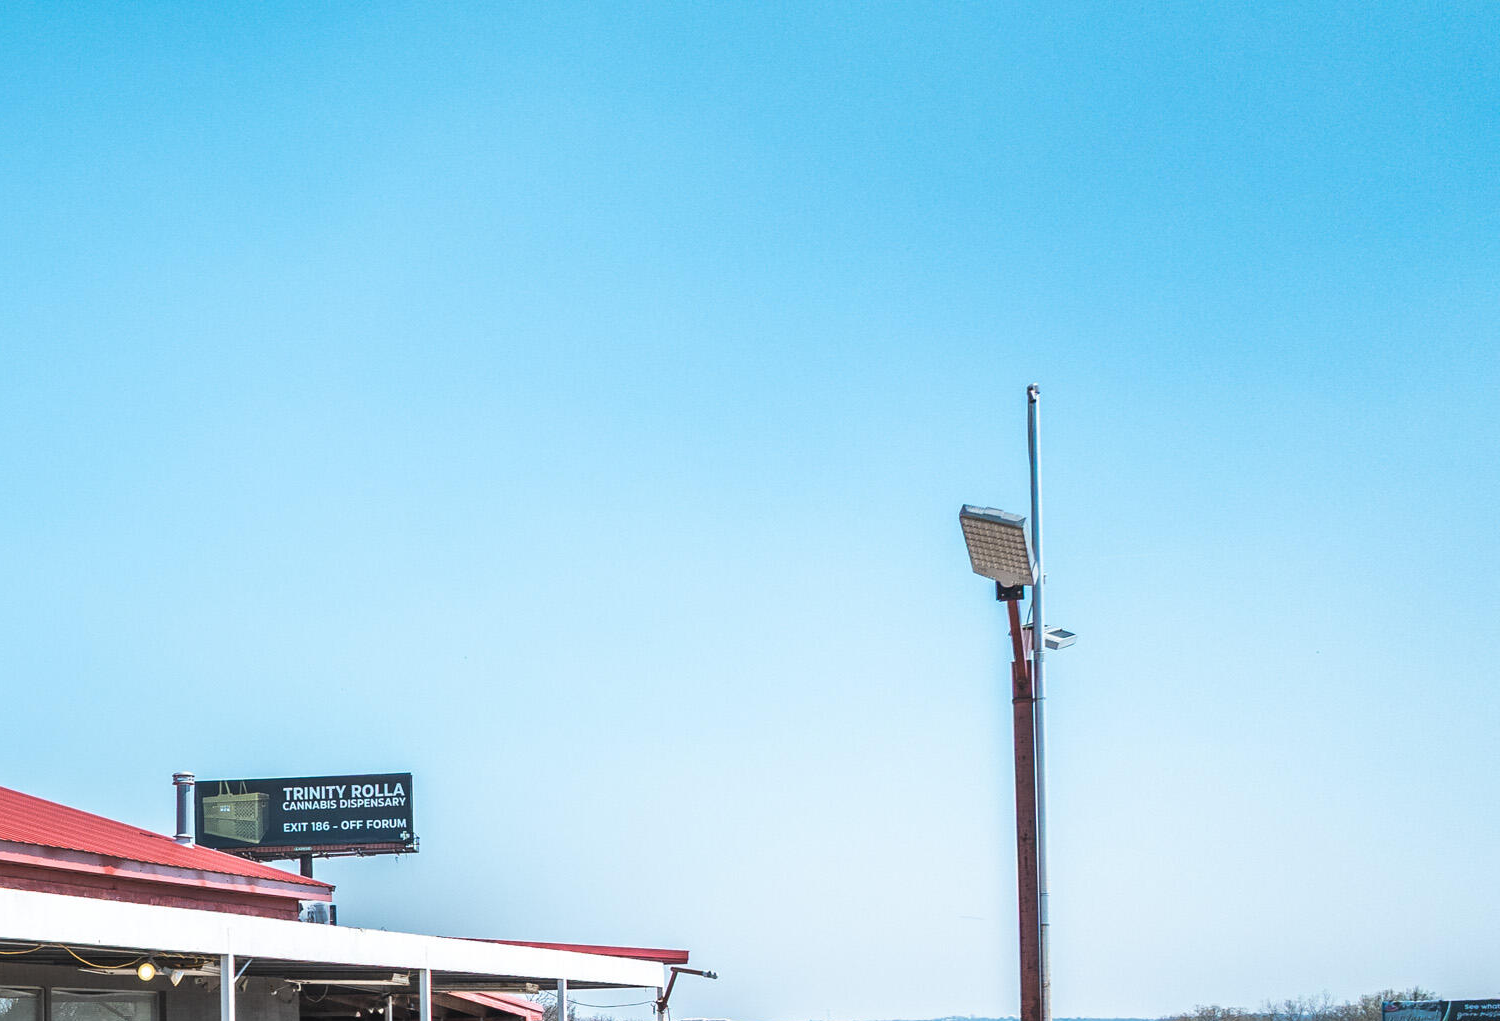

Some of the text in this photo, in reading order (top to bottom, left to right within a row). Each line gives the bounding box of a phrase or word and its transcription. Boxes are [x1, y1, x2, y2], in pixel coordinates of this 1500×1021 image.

[283, 782, 405, 801] TRINITY ROLLA
[282, 797, 406, 811] CANNABIS DISPENSARY
[283, 822, 308, 833] EXIT
[311, 821, 330, 832] 186
[341, 820, 363, 830] OFF
[366, 818, 407, 829] FORUM
